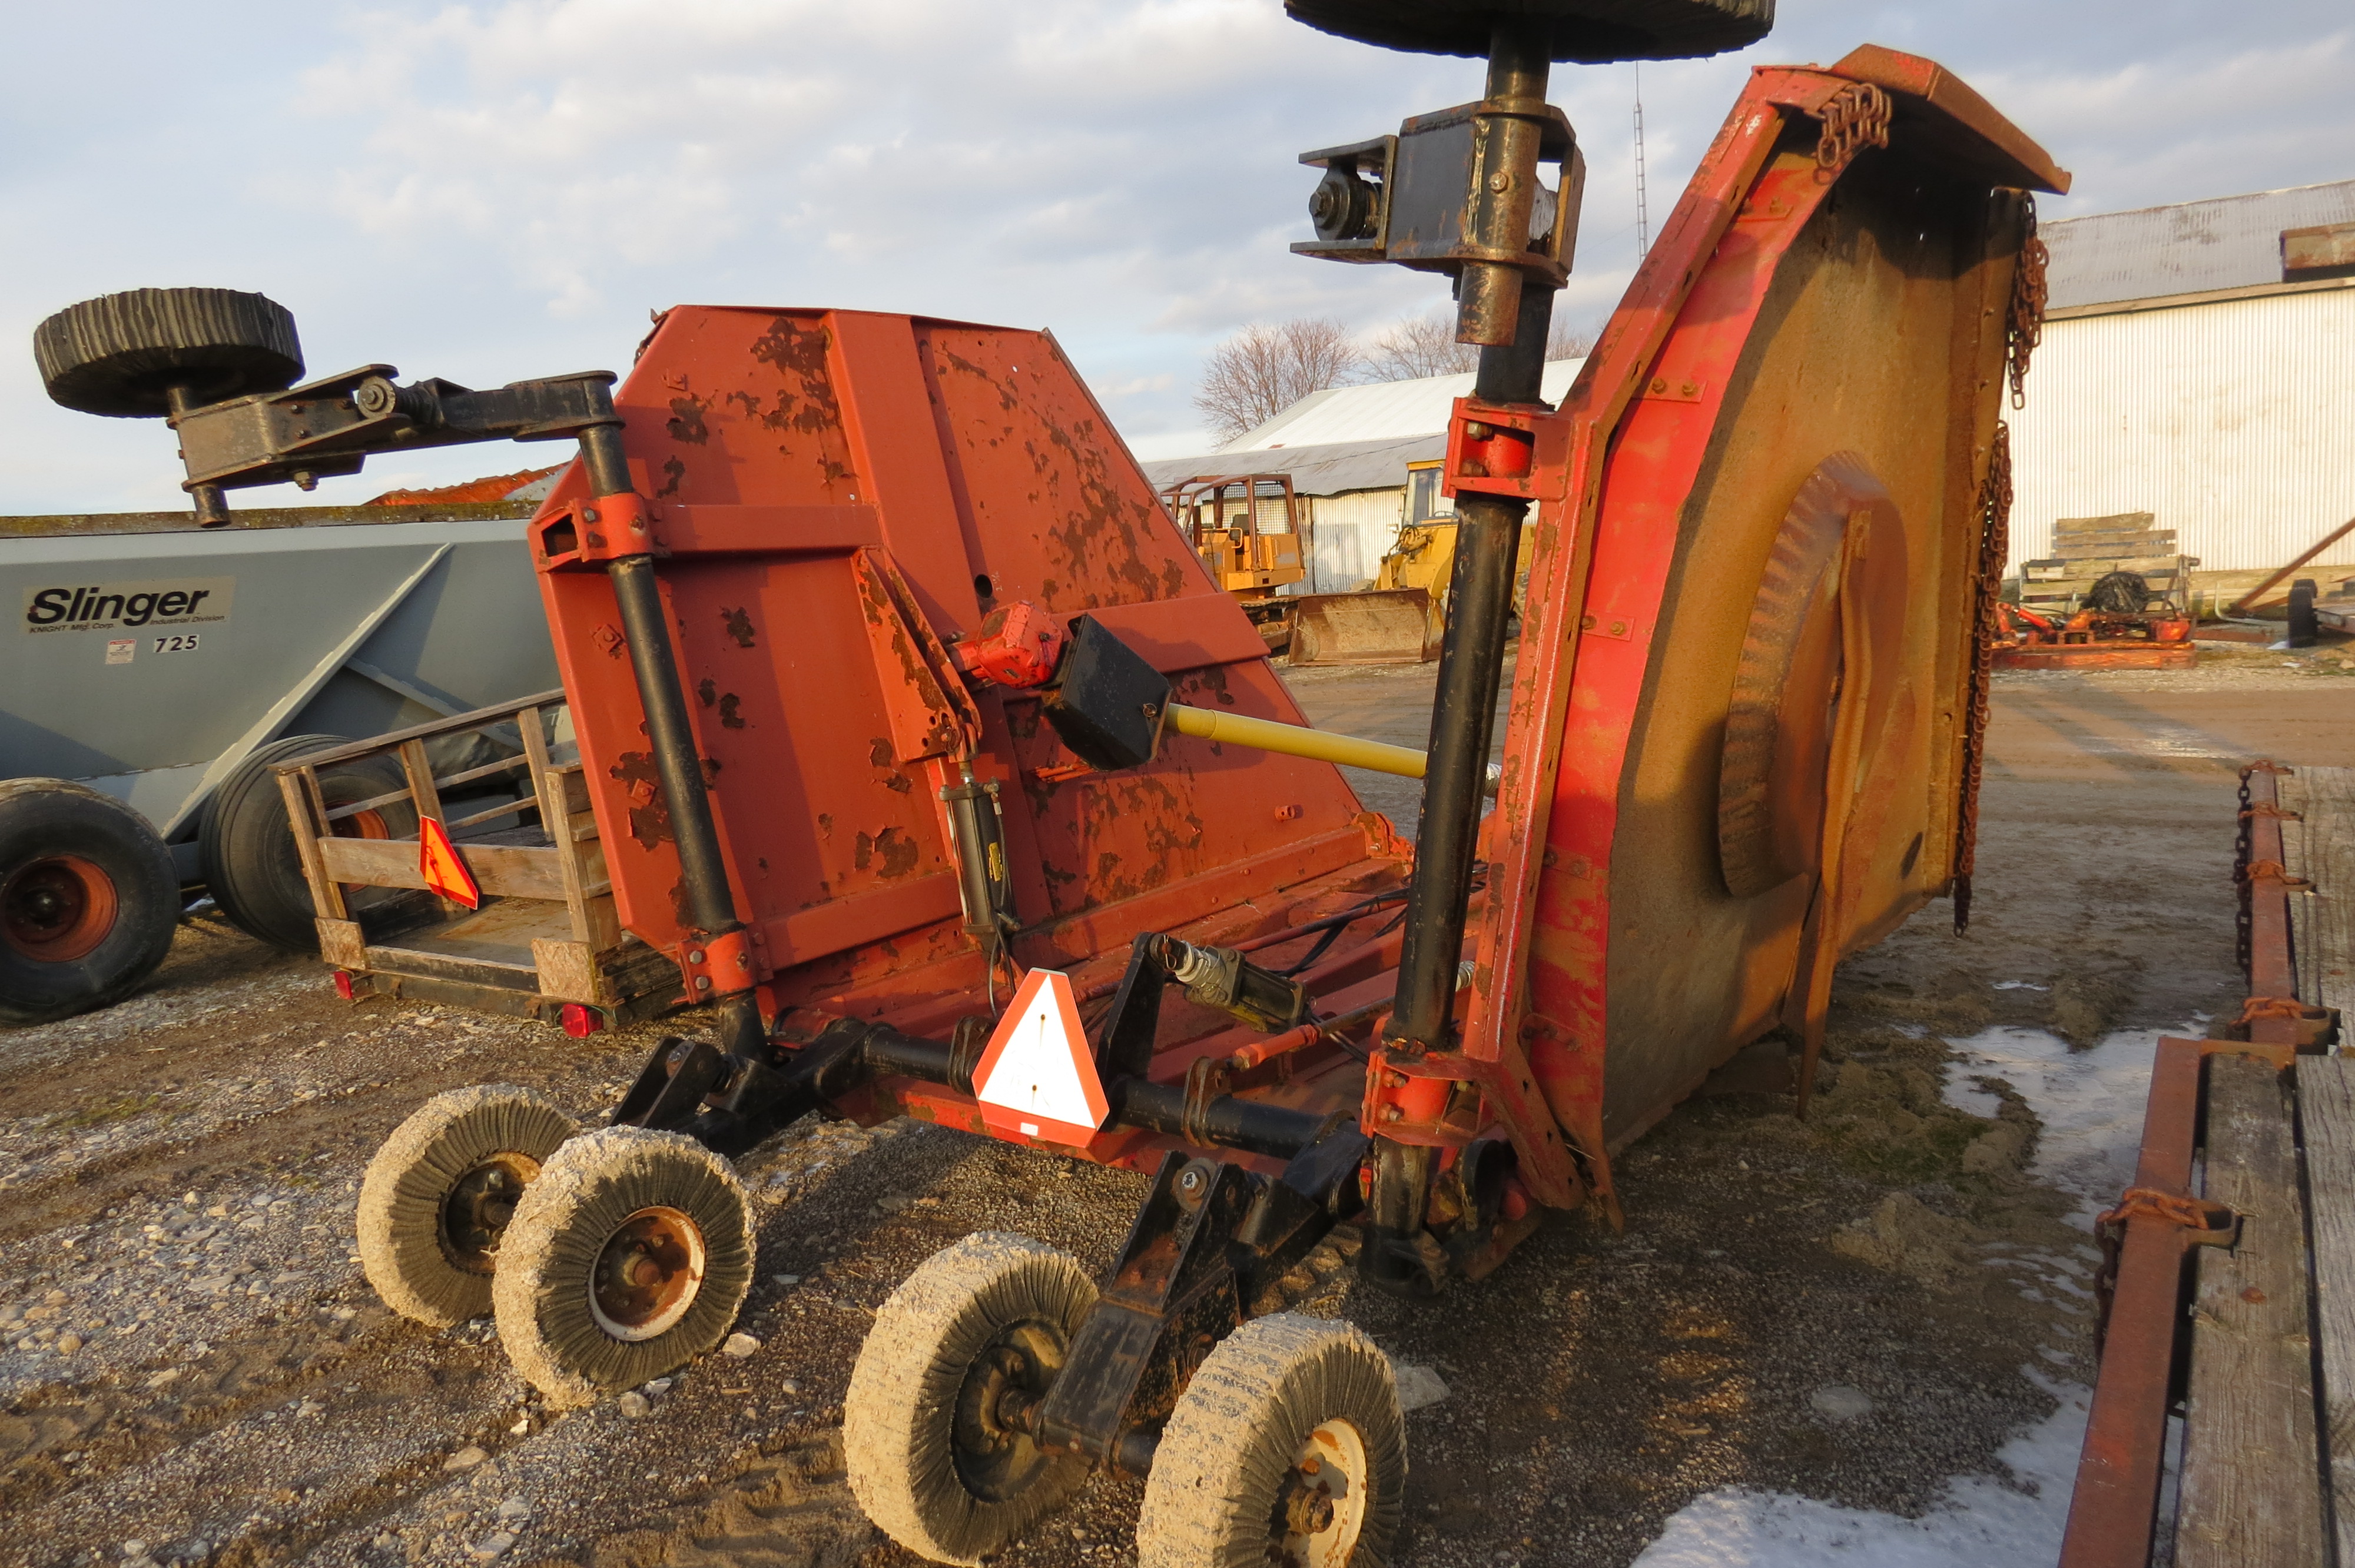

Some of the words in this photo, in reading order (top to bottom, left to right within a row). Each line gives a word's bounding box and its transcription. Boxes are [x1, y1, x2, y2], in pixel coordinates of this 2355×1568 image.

[27, 587, 210, 626] Slinger
[150, 617, 190, 625] Industrial
[29, 624, 67, 633] KNIGHT
[155, 635, 197, 653] 725
